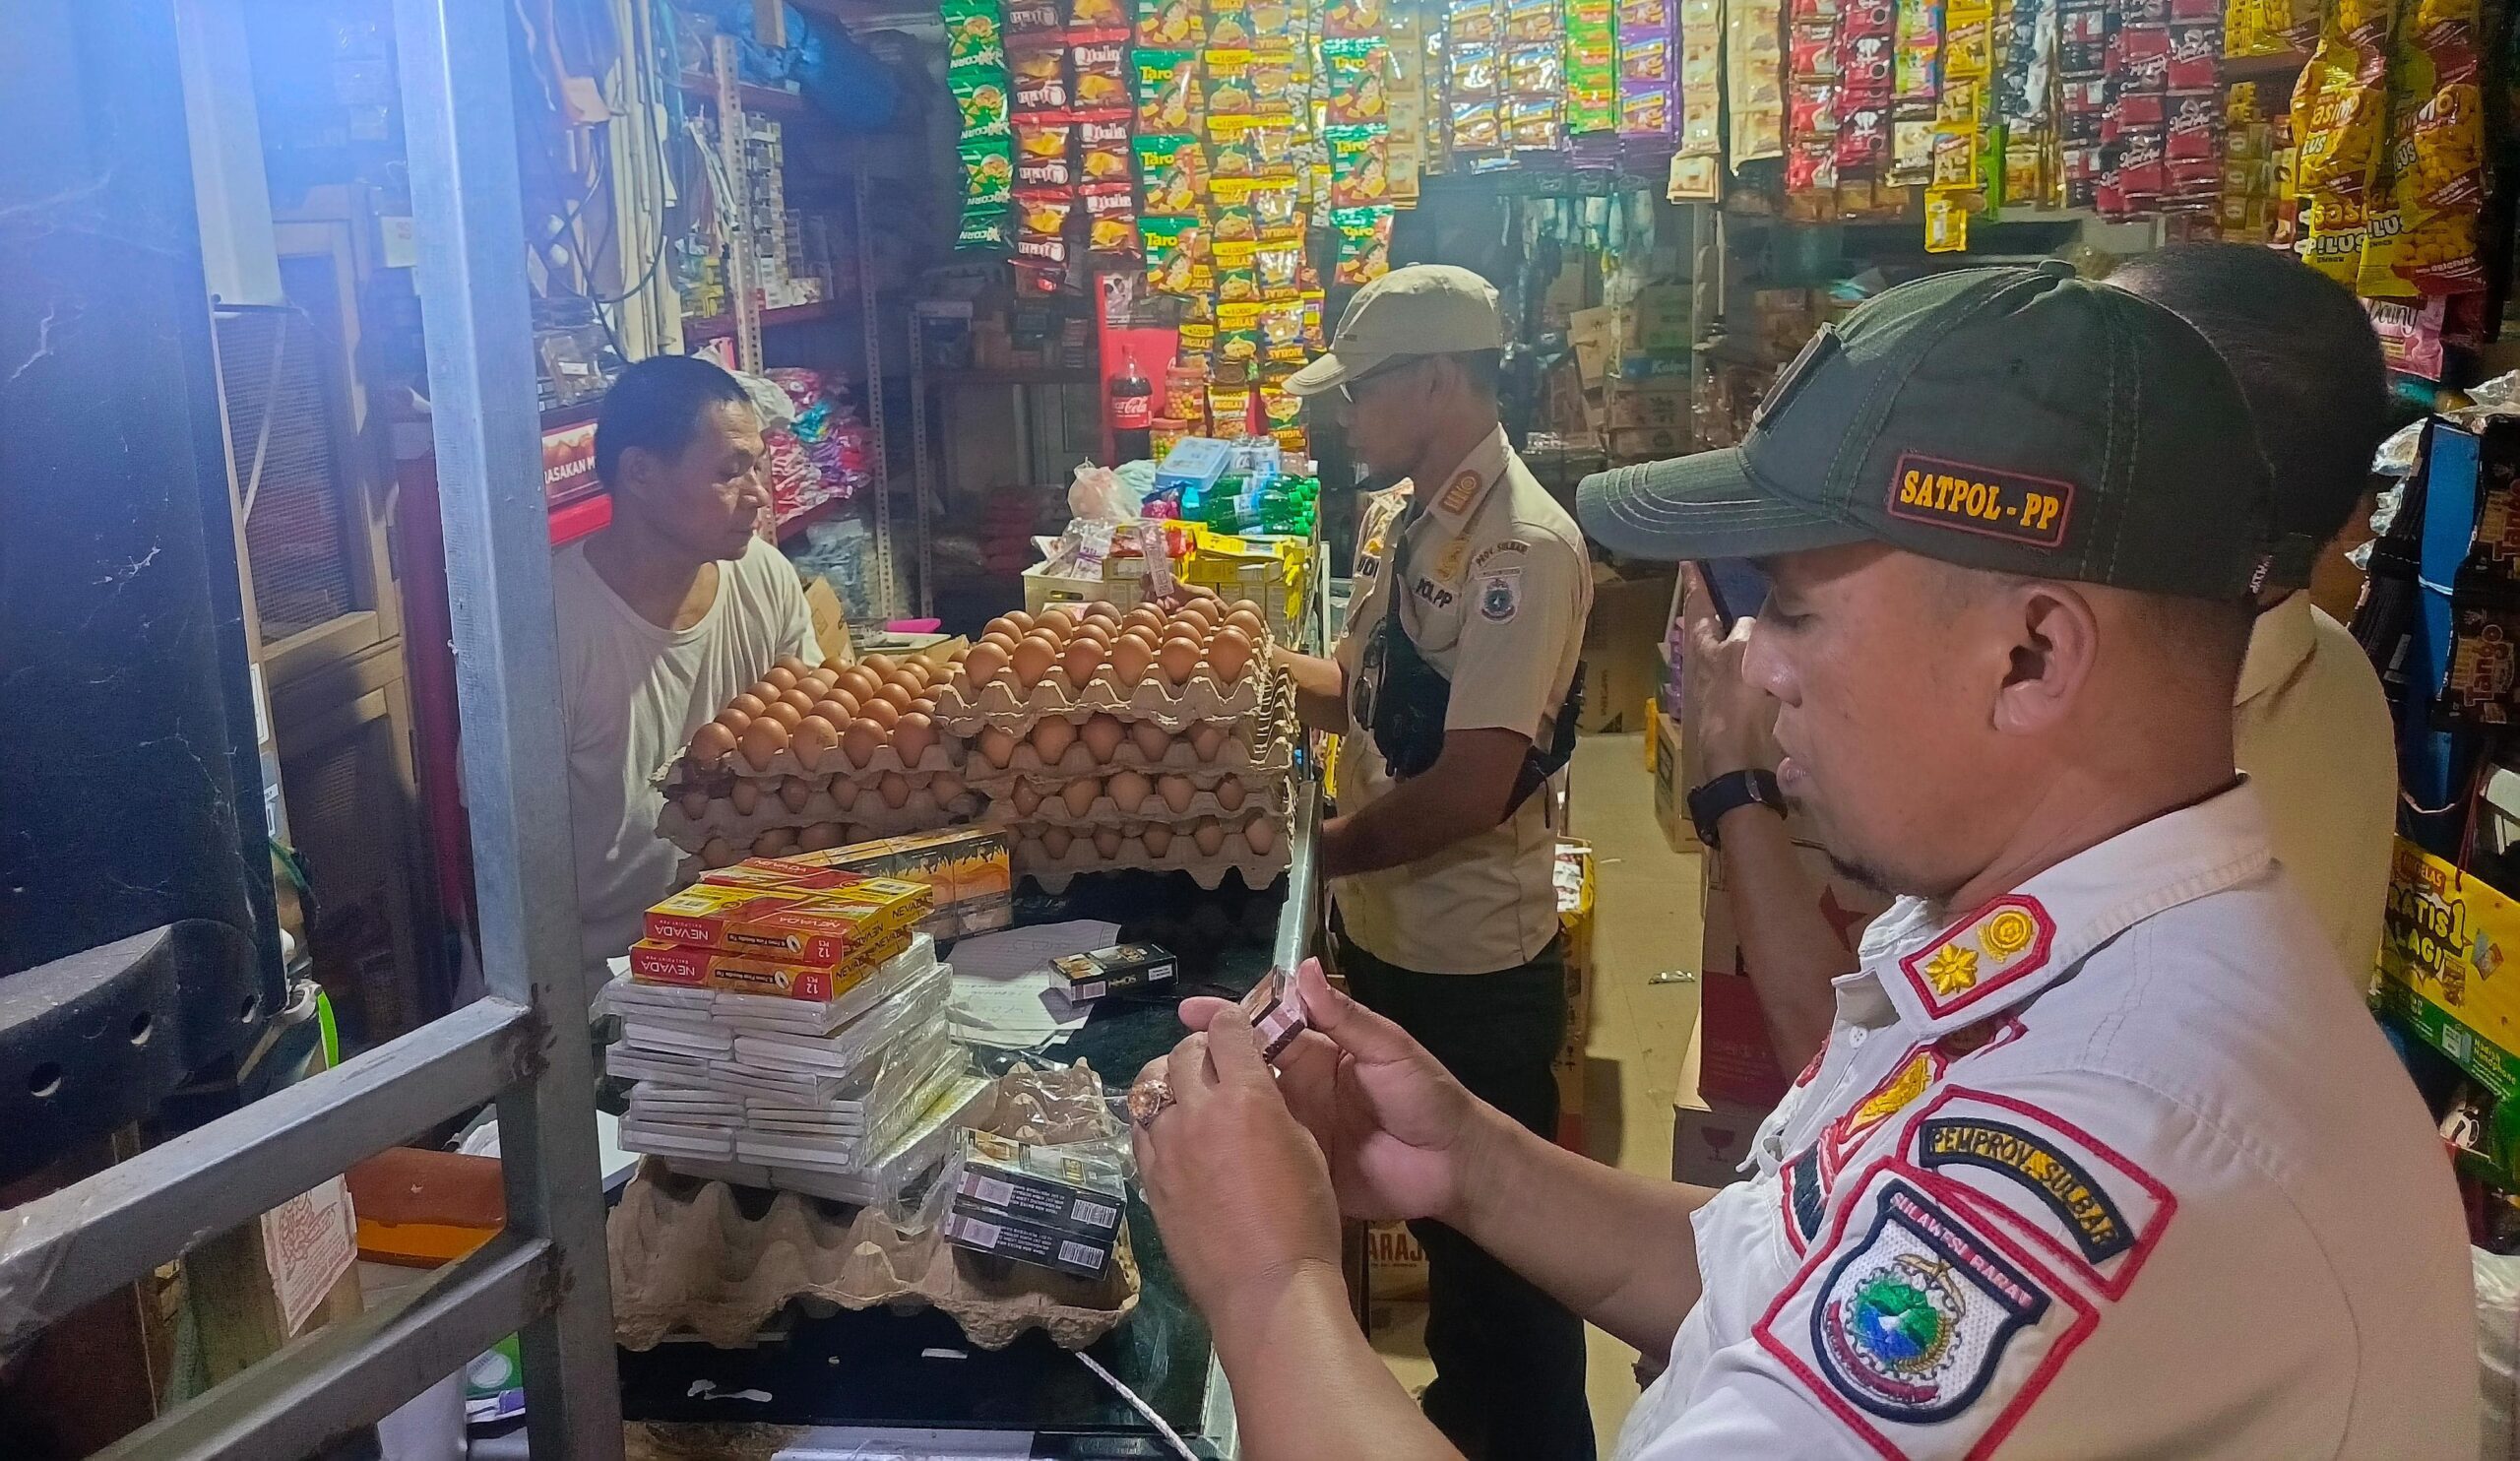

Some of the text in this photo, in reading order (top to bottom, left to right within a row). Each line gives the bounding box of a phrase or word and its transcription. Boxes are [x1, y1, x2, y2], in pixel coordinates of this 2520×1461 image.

[1140, 66, 1173, 81] Taro
[1334, 140, 1367, 154] Taro
[1141, 152, 1174, 165] Taro
[1145, 232, 1178, 247] Taro
[1900, 470, 2001, 521] SATPOL
[2019, 492, 2059, 530] PP
[2463, 624, 2502, 707] Tango
[655, 924, 709, 941] NEVADA
[818, 947, 831, 958] 12
[641, 960, 695, 977] NEVADA
[807, 983, 819, 994] 12
[1369, 1233, 1430, 1261] ARAJ
